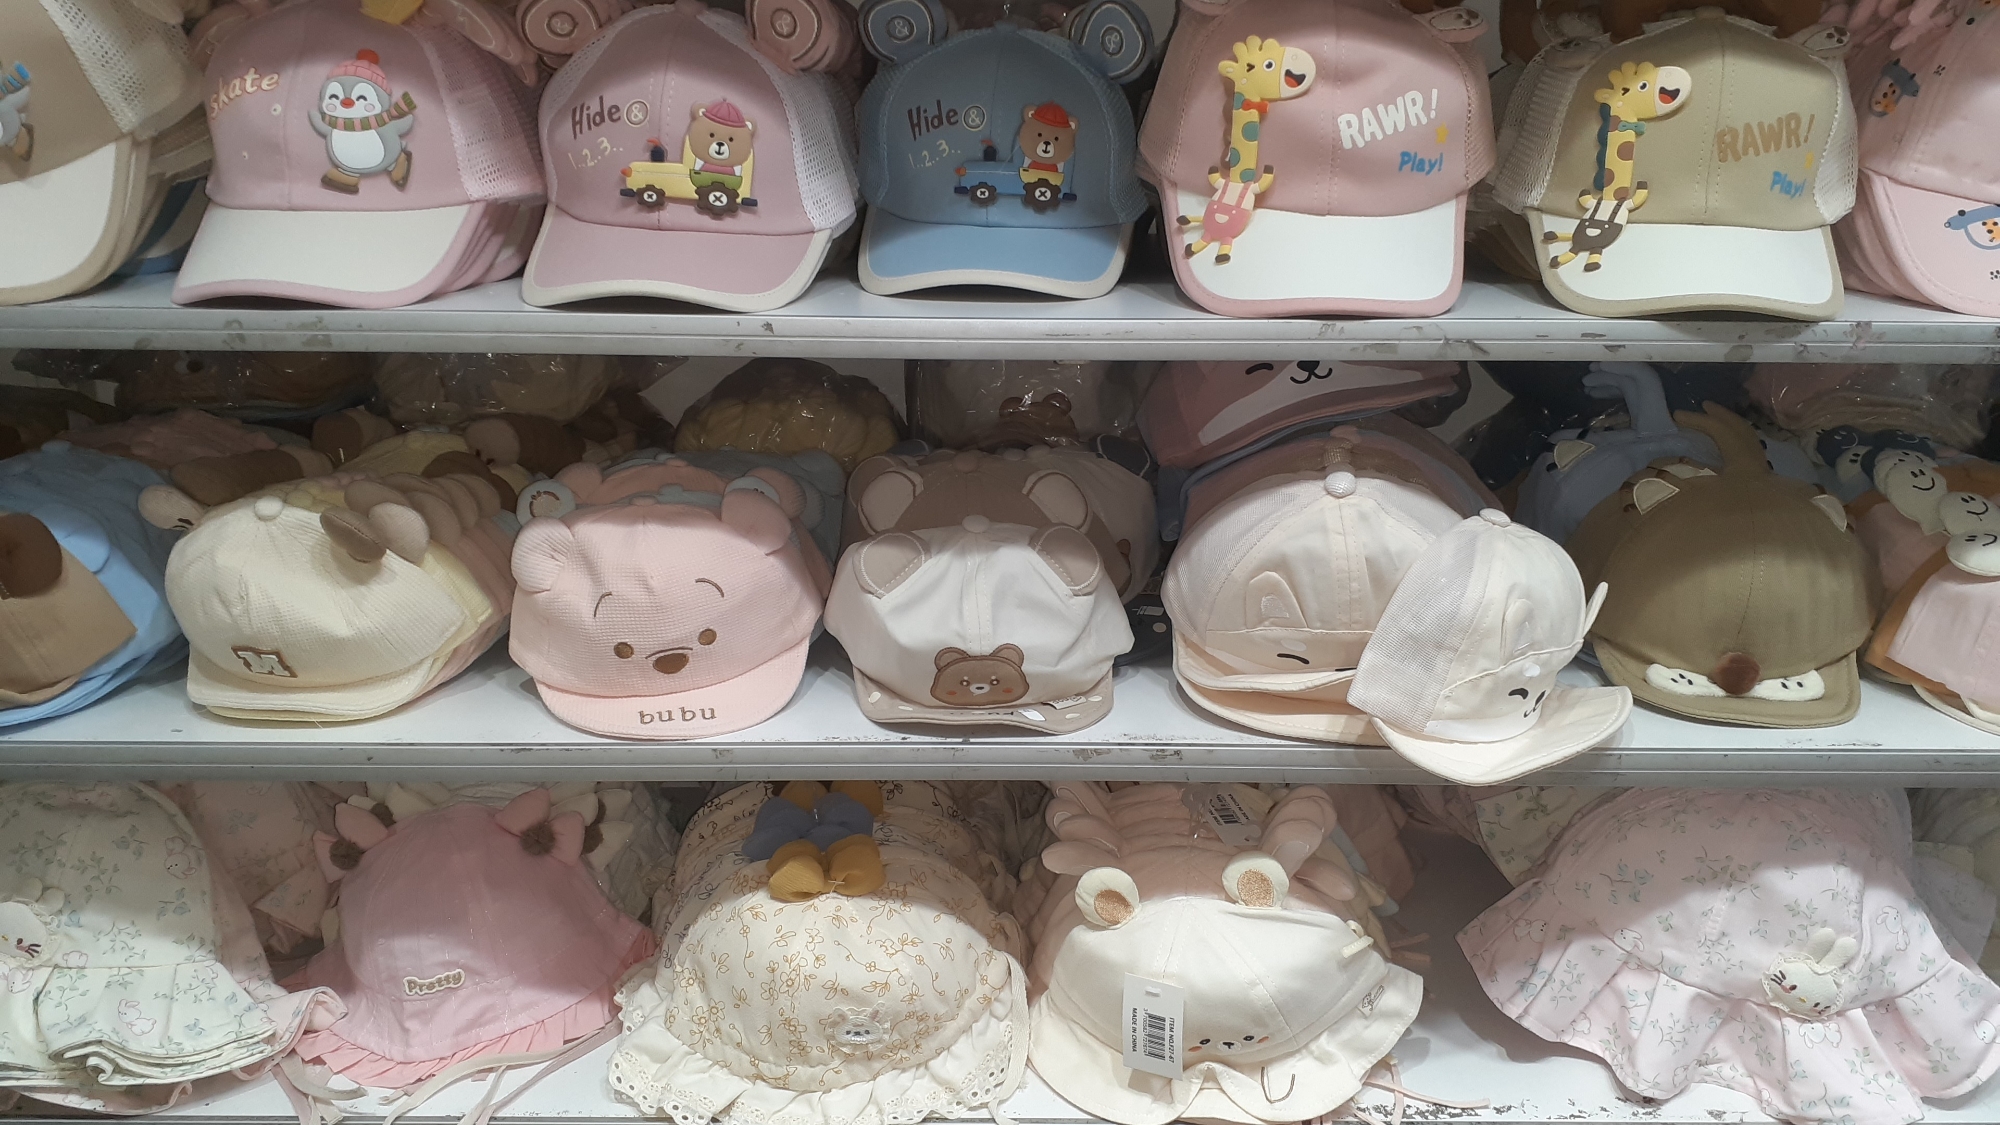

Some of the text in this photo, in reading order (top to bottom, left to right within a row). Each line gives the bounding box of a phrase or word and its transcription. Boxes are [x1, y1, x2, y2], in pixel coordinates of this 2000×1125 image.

[571, 95, 621, 140] Hide
[907, 99, 959, 141] Hide
[1337, 88, 1438, 150] RAWR!
[1716, 112, 1815, 163] RAWR!
[1398, 151, 1443, 176] Play!
